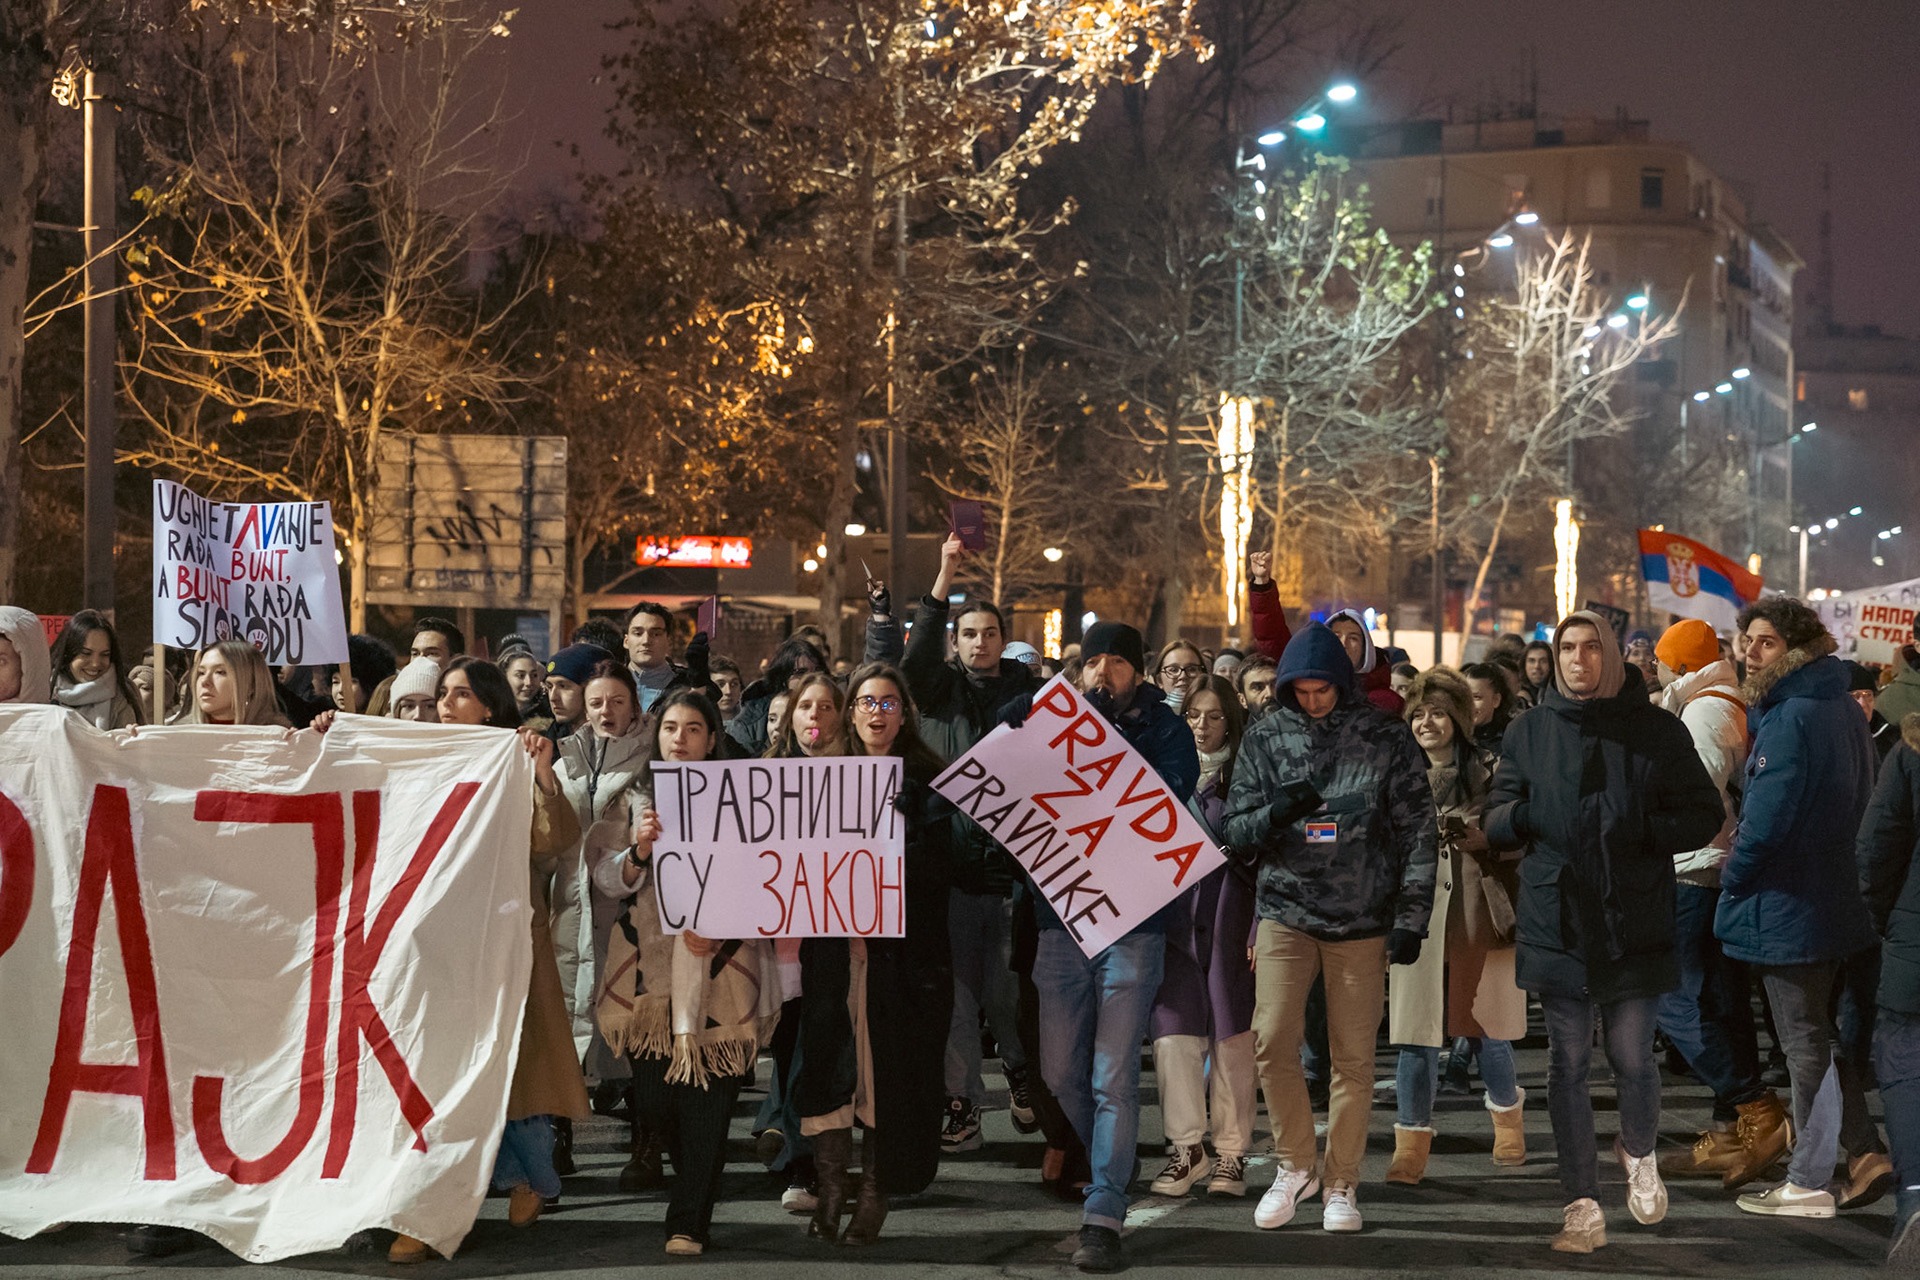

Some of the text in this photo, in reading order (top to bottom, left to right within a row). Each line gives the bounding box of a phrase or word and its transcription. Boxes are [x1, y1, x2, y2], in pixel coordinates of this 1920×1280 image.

[158, 483, 324, 552] UGNJETAVANJE
[168, 529, 291, 584] RAĐA BUNT,
[158, 565, 312, 619] A BUNT RAĐA
[1862, 604, 1914, 626] НАПА
[176, 597, 304, 665] SLOBODU
[1860, 625, 1913, 644] СТУДЕ
[650, 763, 897, 844] ПРАВНИЦИ
[1023, 681, 1205, 888] PRAVDA
[1031, 768, 1115, 859] ZA
[935, 757, 1121, 944] PRAVNIKE
[656, 849, 902, 936] СУ ЗАКОН
